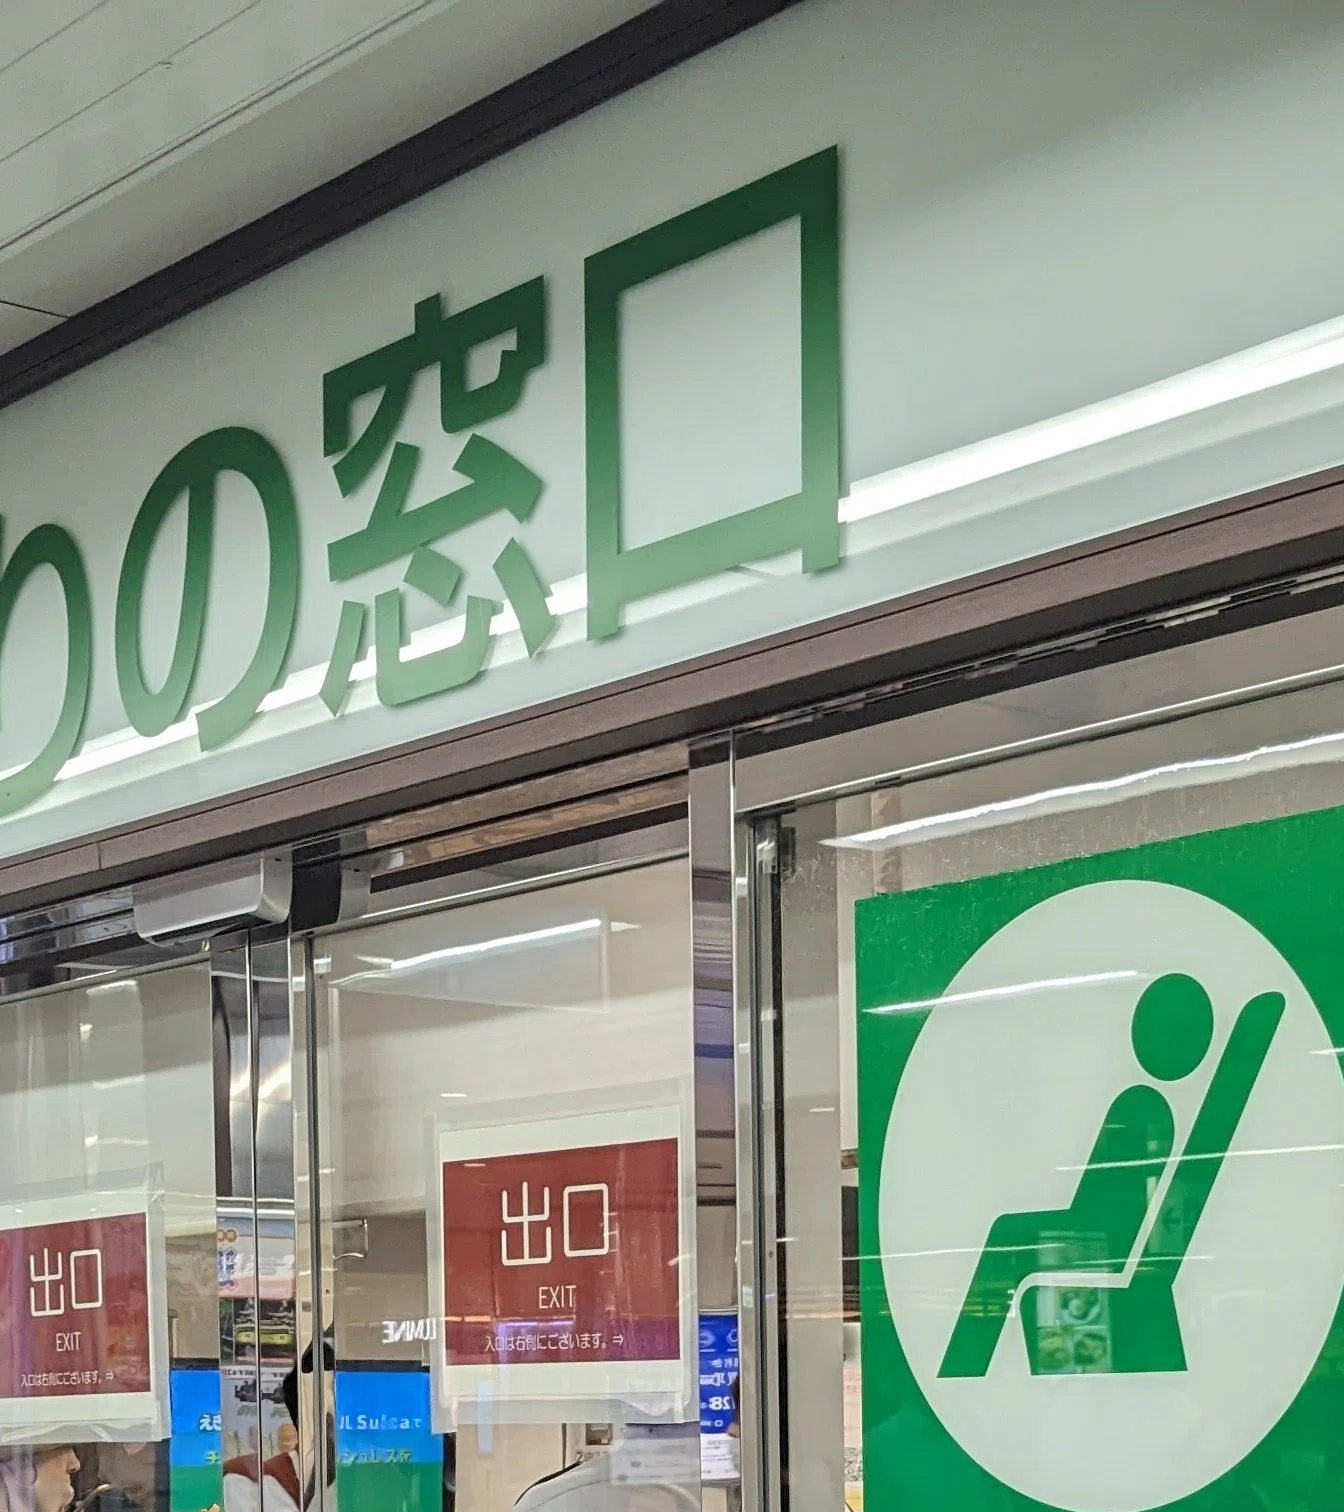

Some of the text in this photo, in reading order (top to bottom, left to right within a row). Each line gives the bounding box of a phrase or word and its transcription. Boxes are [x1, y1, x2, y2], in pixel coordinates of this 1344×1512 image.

[502, 1181, 609, 1266] 出口
[29, 1247, 103, 1317] 出口
[538, 1284, 577, 1309] EXIT
[55, 1331, 82, 1352] EXIT
[484, 1332, 606, 1352] 入口は右側にございます。
